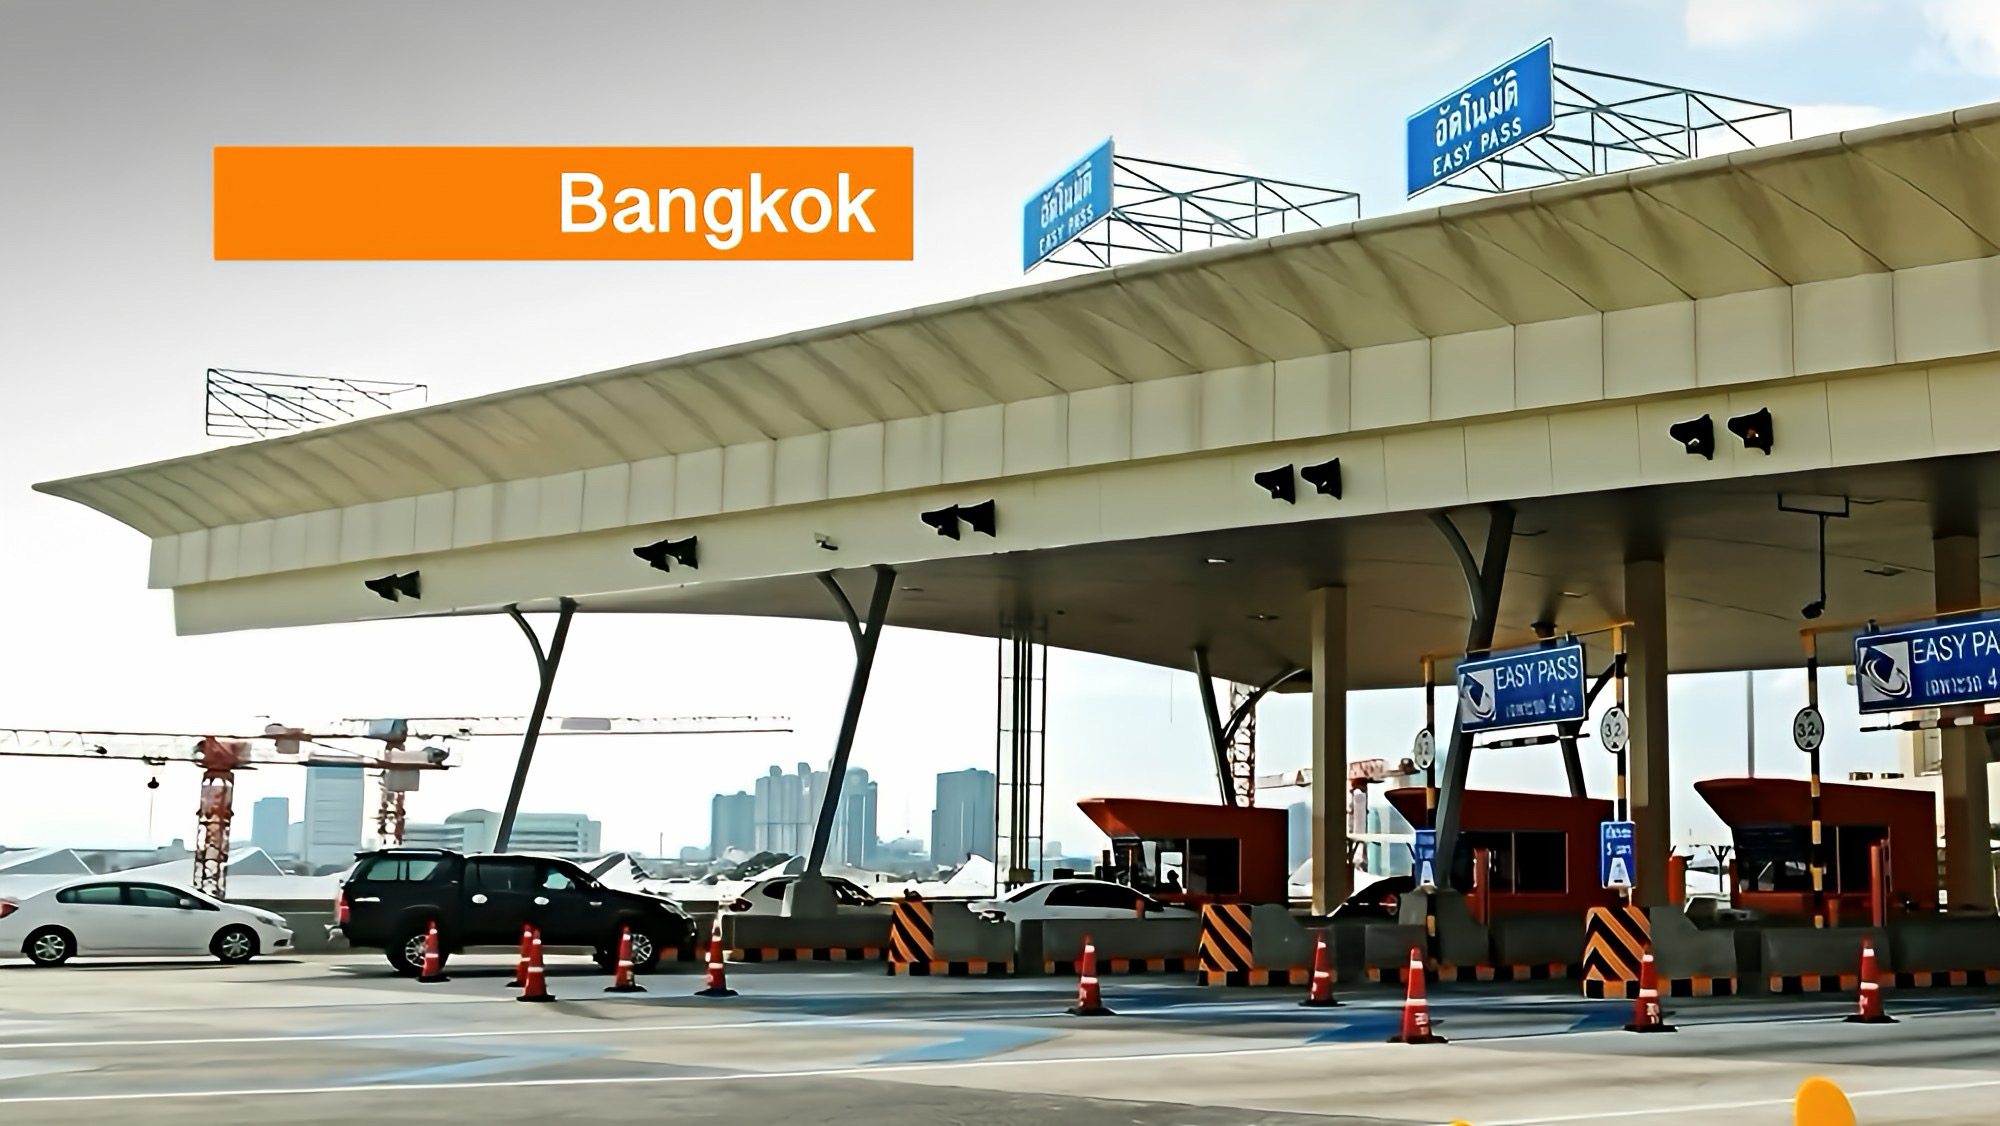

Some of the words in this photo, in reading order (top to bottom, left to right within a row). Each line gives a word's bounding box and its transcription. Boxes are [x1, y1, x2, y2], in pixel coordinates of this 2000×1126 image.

[1432, 140, 1473, 177] EASY
[1480, 116, 1523, 153] PASS
[1039, 223, 1065, 256] EASY
[1067, 203, 1094, 236] PASS
[1912, 632, 1967, 664] EASY
[1495, 662, 1536, 690] EASY
[1537, 655, 1579, 684] PASS
[1987, 667, 1998, 691] 4
[1548, 692, 1557, 713] 4
